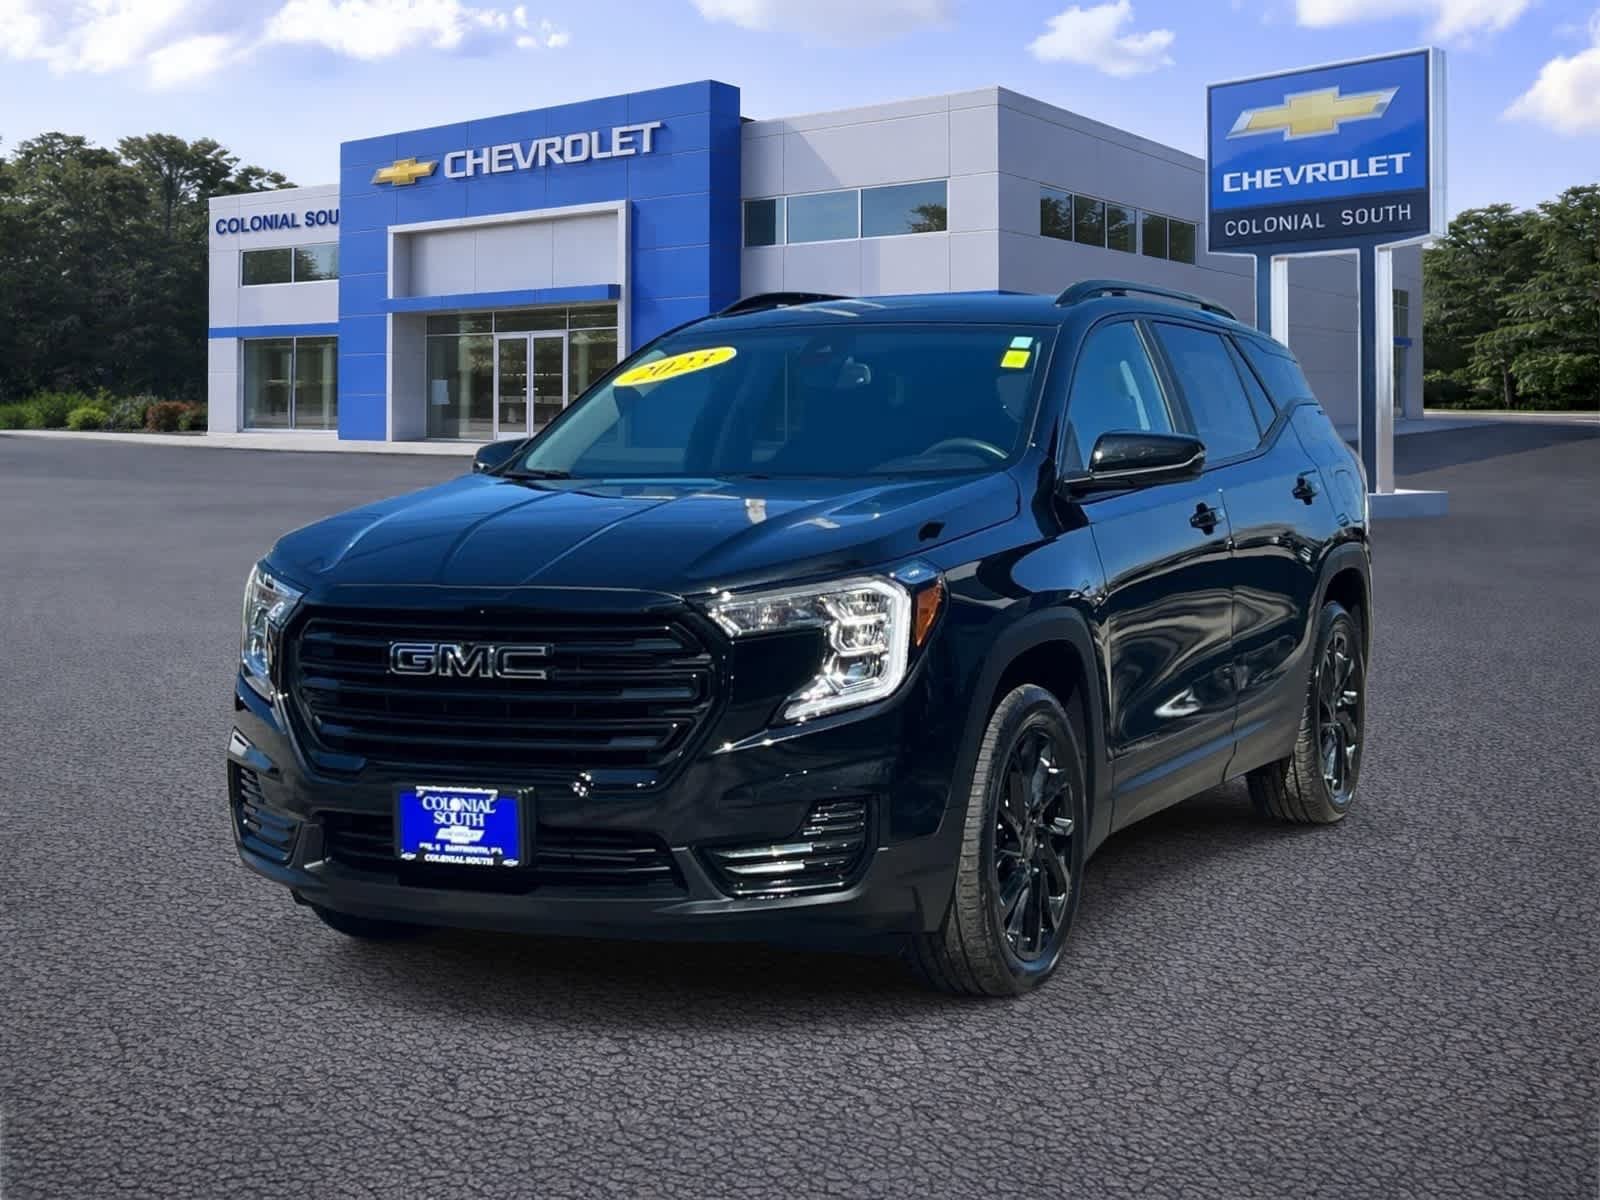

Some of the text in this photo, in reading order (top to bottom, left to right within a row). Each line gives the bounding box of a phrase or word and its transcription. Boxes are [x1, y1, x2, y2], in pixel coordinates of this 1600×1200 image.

[443, 121, 663, 180] CHEVROLET
[1223, 152, 1411, 192] CHEVROLET
[215, 213, 301, 235] COLONIAL
[1224, 203, 1412, 237] COLONIAL SOUTH
[390, 642, 547, 679] GMC
[422, 796, 496, 814] COLONIAL
[433, 810, 485, 827] SOUTH
[424, 853, 494, 866] COLONIAL SOUTH
